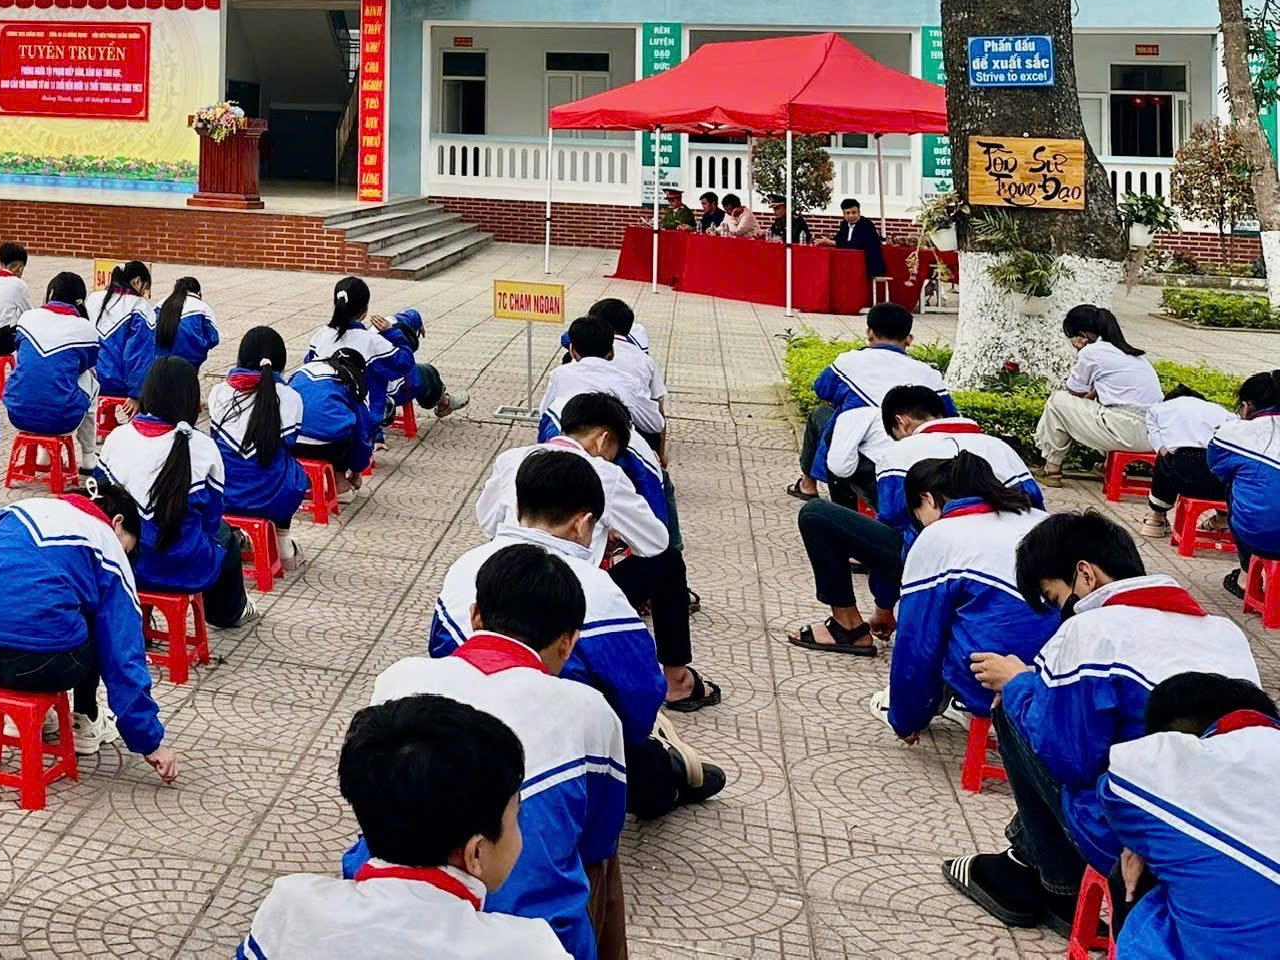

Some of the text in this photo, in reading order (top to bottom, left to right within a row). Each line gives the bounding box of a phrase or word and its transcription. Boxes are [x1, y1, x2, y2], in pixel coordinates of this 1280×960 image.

[654, 26, 670, 34] RÈN
[19, 41, 126, 61] TUYÊN TRUYỀN
[649, 38, 674, 47] LUYỆN
[984, 38, 1035, 52] Phấn đấu
[972, 53, 1049, 72] để xuất sắc
[976, 71, 1047, 82] Strive to excel
[977, 141, 1018, 173] Tôn
[1038, 174, 1082, 203] Đạo
[97, 271, 105, 286] 9A
[498, 293, 507, 309] 7C
[534, 295, 560, 314] NGOAN
